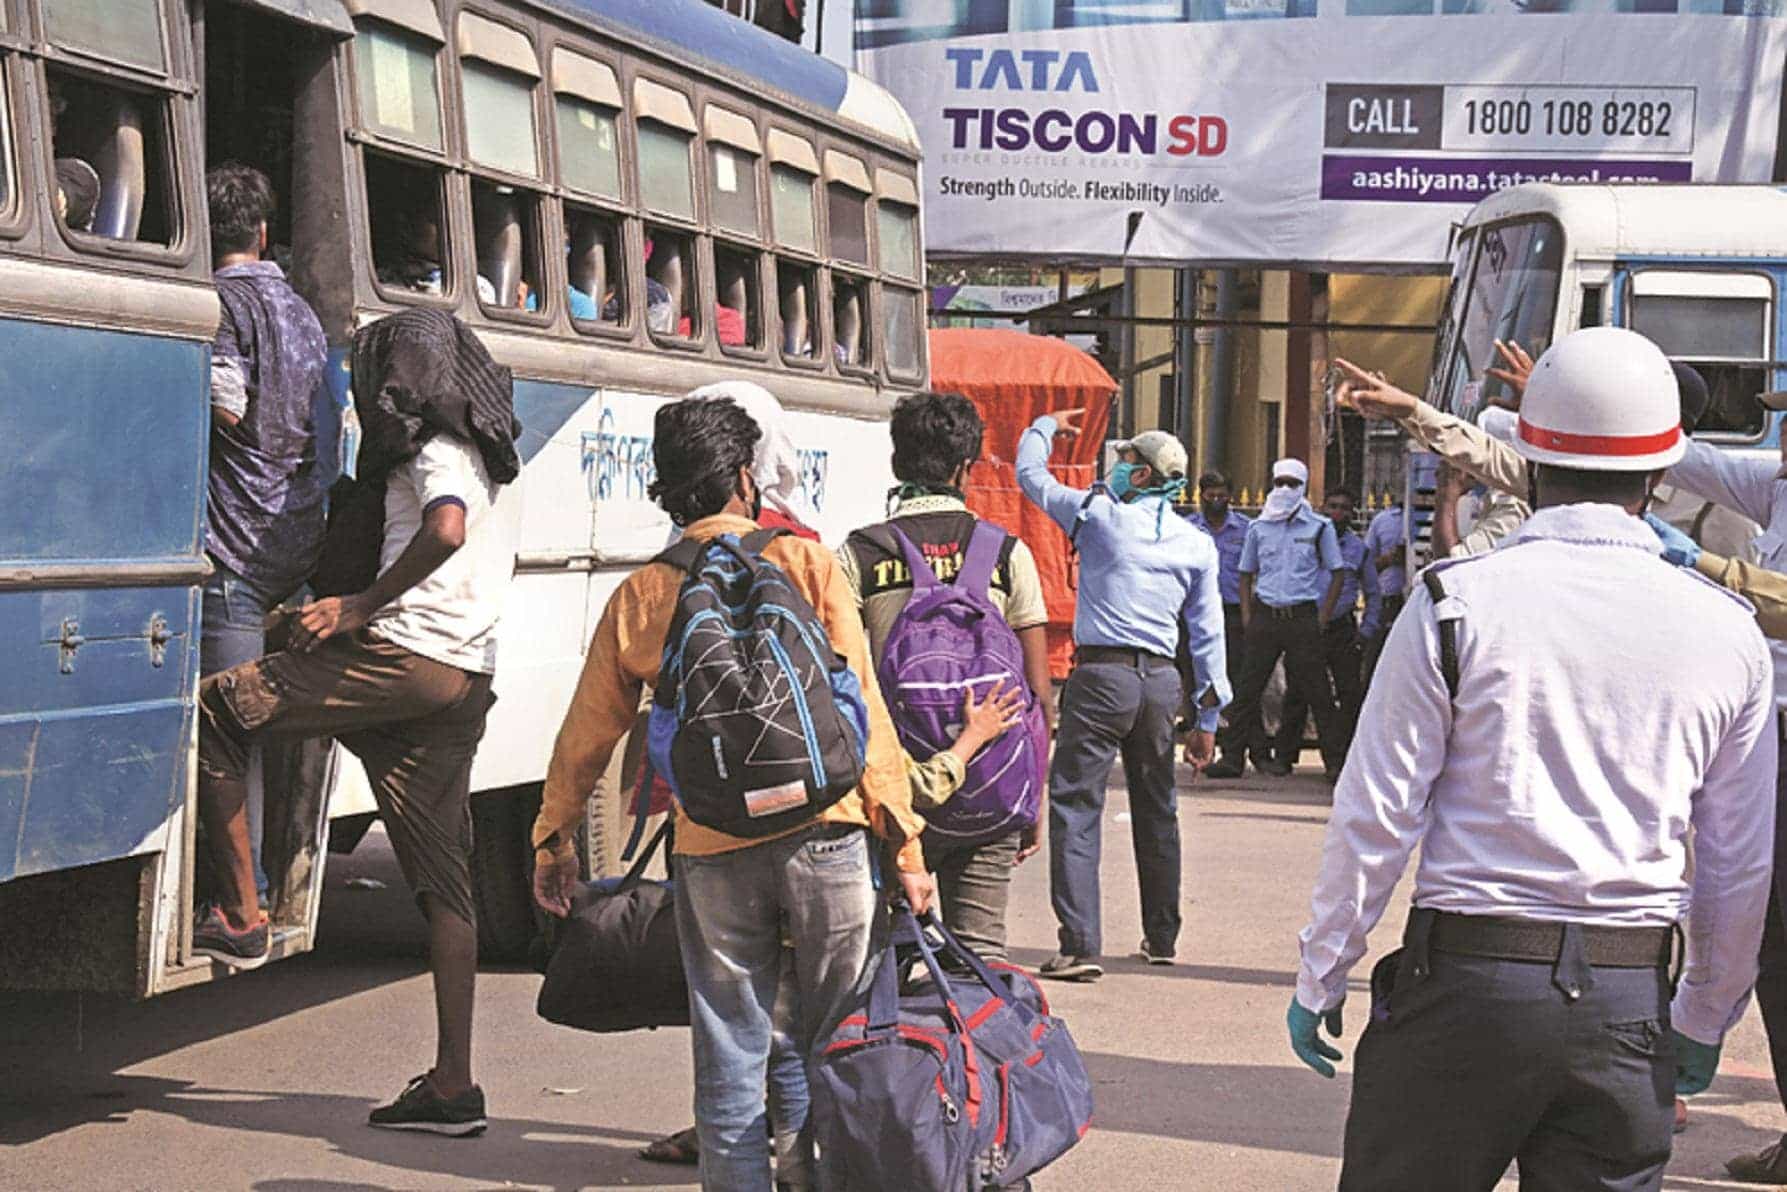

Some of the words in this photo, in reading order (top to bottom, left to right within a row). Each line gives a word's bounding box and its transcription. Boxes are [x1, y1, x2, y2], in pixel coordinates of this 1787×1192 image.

[945, 48, 1100, 93] TATA
[943, 107, 1157, 155] TISCON
[1166, 115, 1228, 157] SD
[1348, 98, 1419, 134] CALL
[1464, 99, 1531, 135] 1800
[1543, 101, 1593, 136] 108
[1602, 101, 1672, 138] 8282
[940, 176, 1015, 201] Strength
[1019, 178, 1081, 199] Outside.
[1084, 180, 1171, 207] Flexibility
[1173, 184, 1225, 203] Inside.
